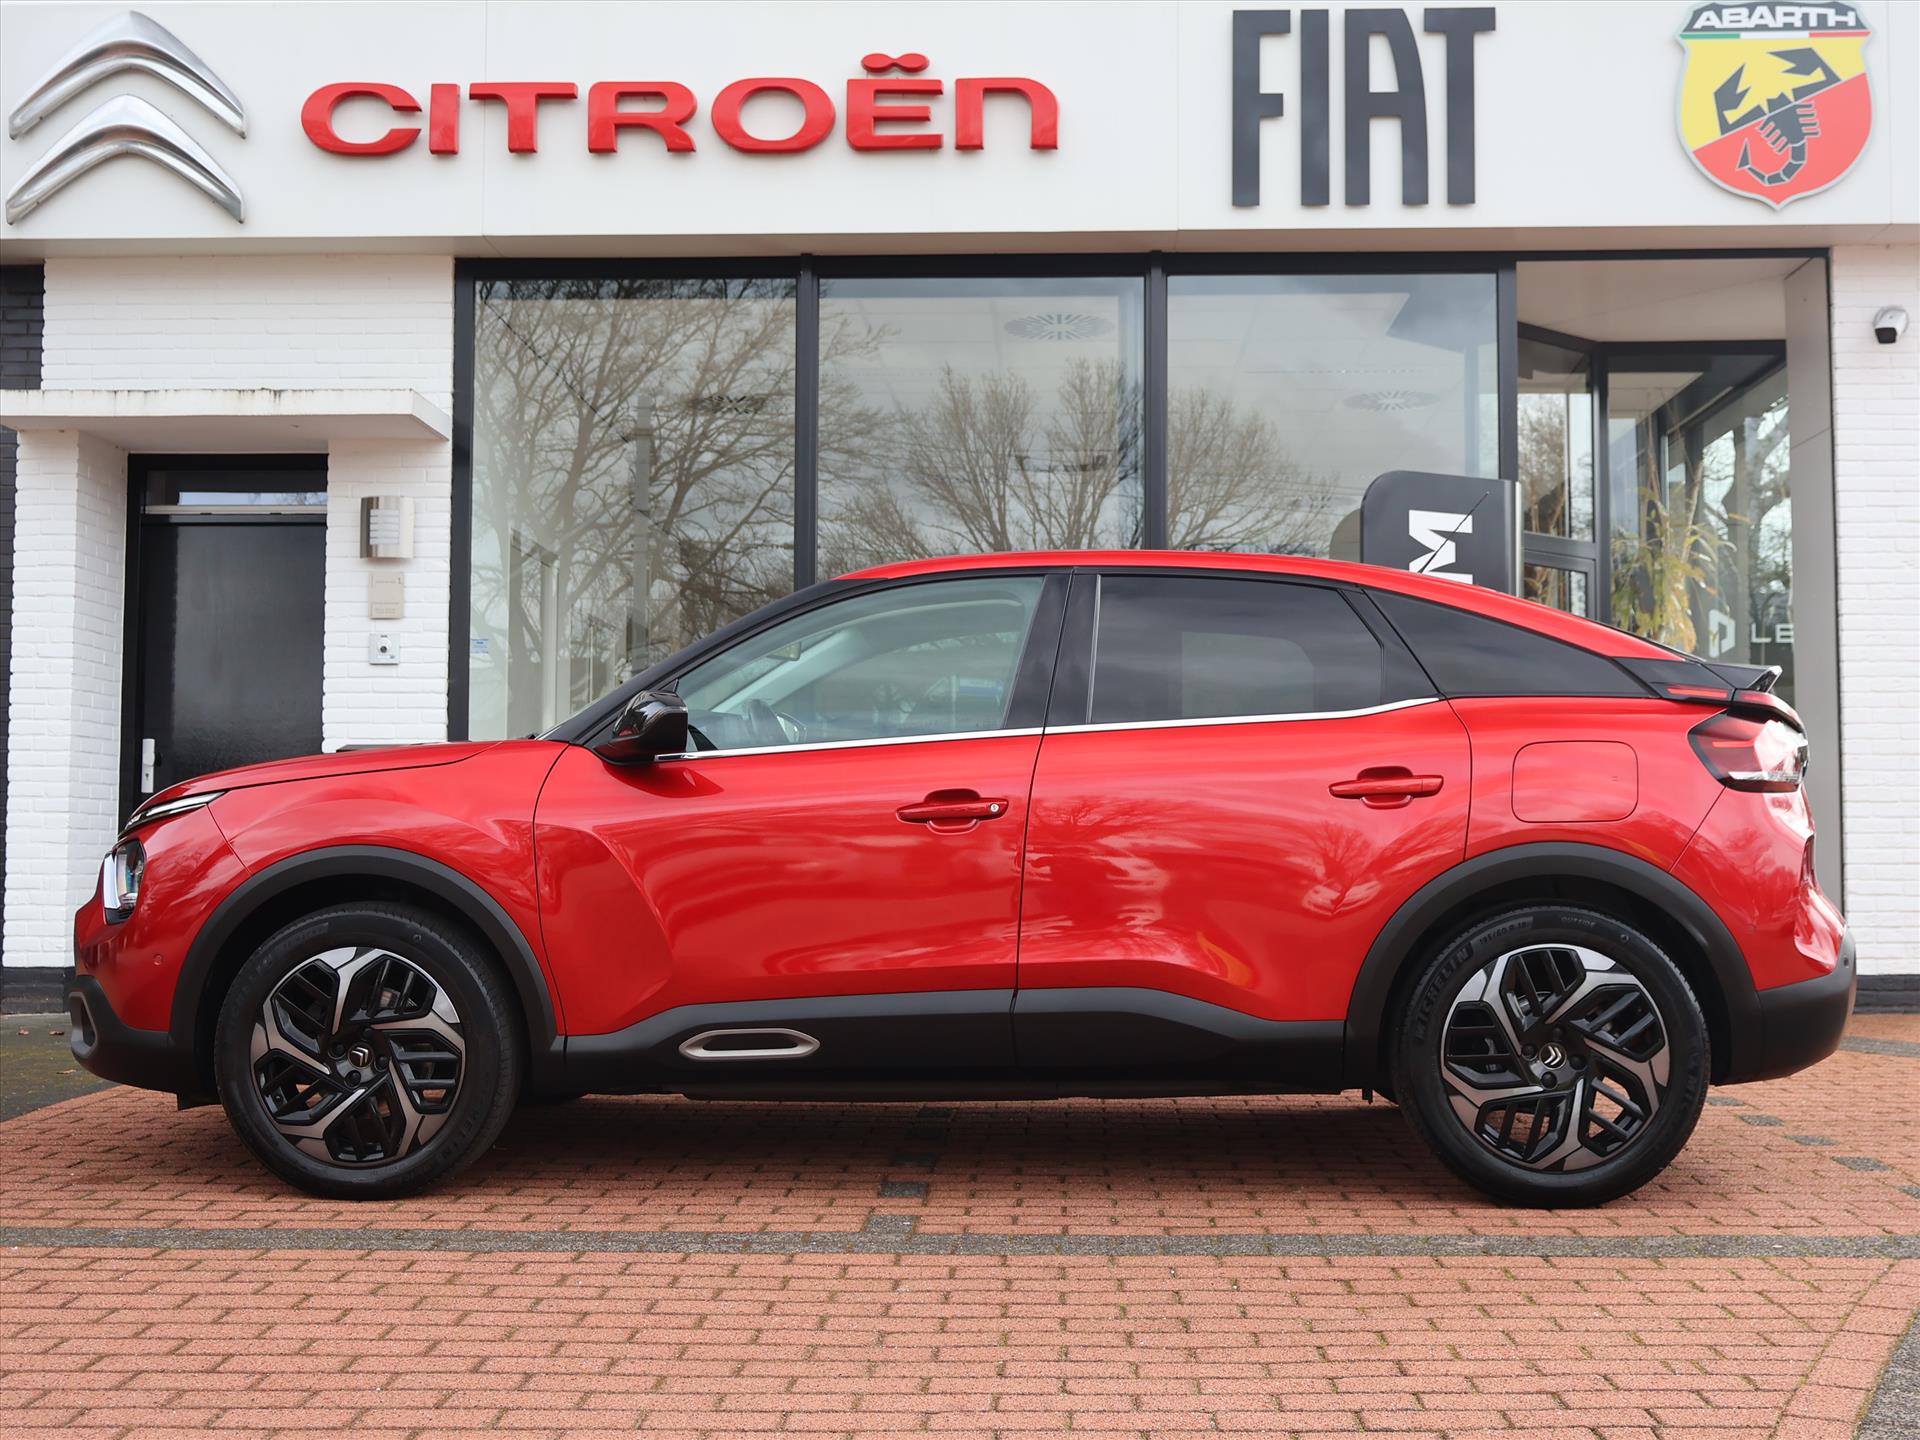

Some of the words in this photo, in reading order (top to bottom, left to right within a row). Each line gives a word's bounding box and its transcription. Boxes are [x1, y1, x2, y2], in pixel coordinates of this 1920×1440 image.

[1692, 5, 1857, 29] ABARTH
[1231, 7, 1496, 207] FIAT
[1414, 946, 1471, 1041] MICHELIN
